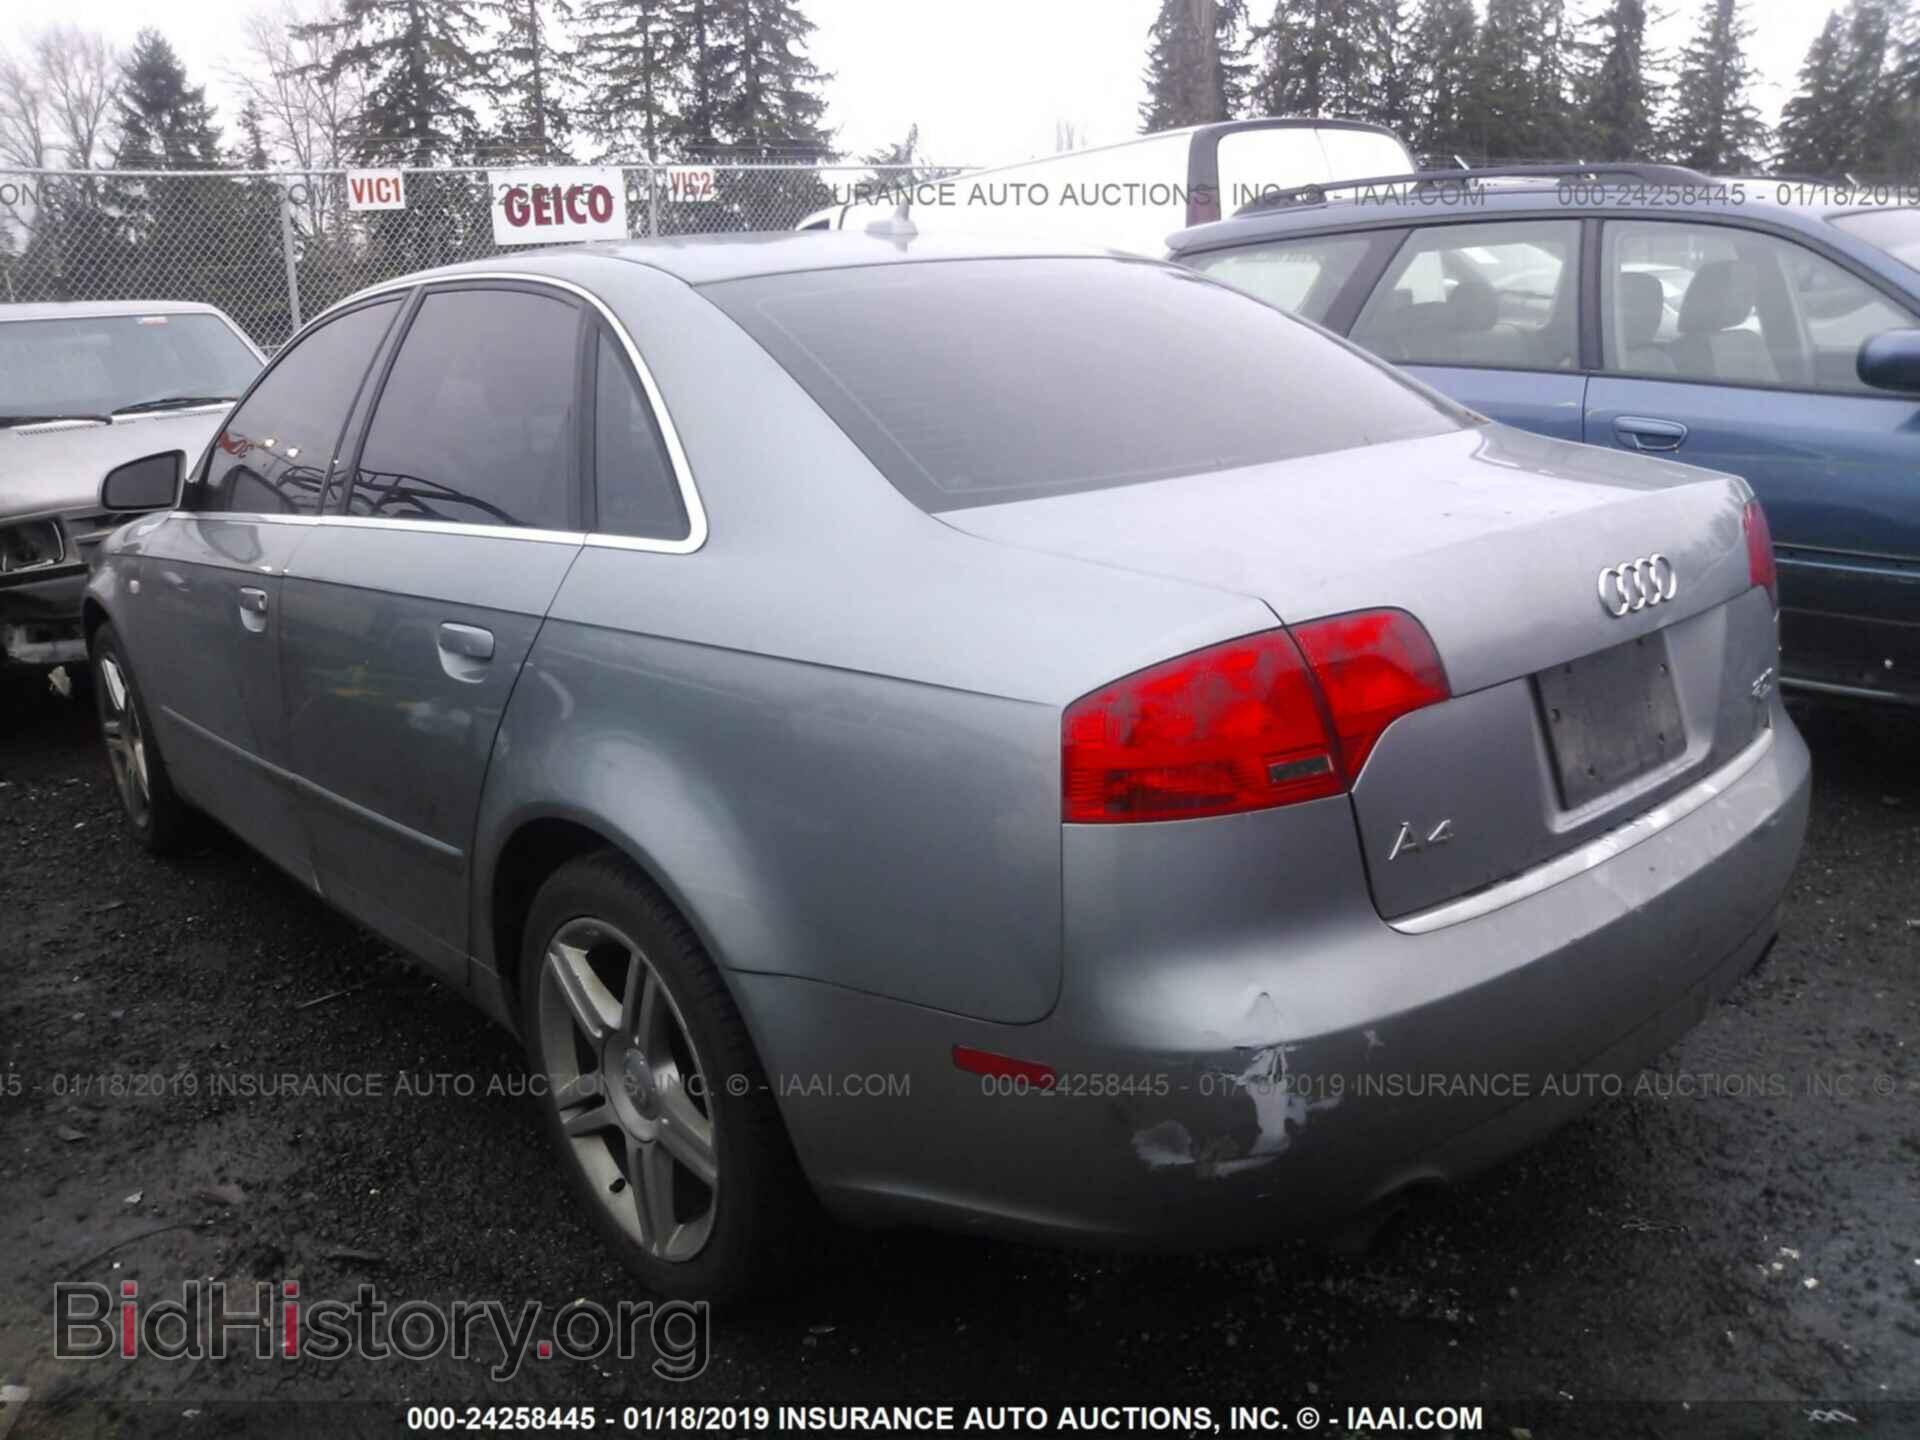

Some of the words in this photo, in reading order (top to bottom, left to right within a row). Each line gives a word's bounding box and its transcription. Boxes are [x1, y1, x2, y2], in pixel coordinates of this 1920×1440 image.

[350, 177, 400, 204] VIC1
[669, 171, 712, 195] VIC2
[504, 184, 614, 227] GEICO
